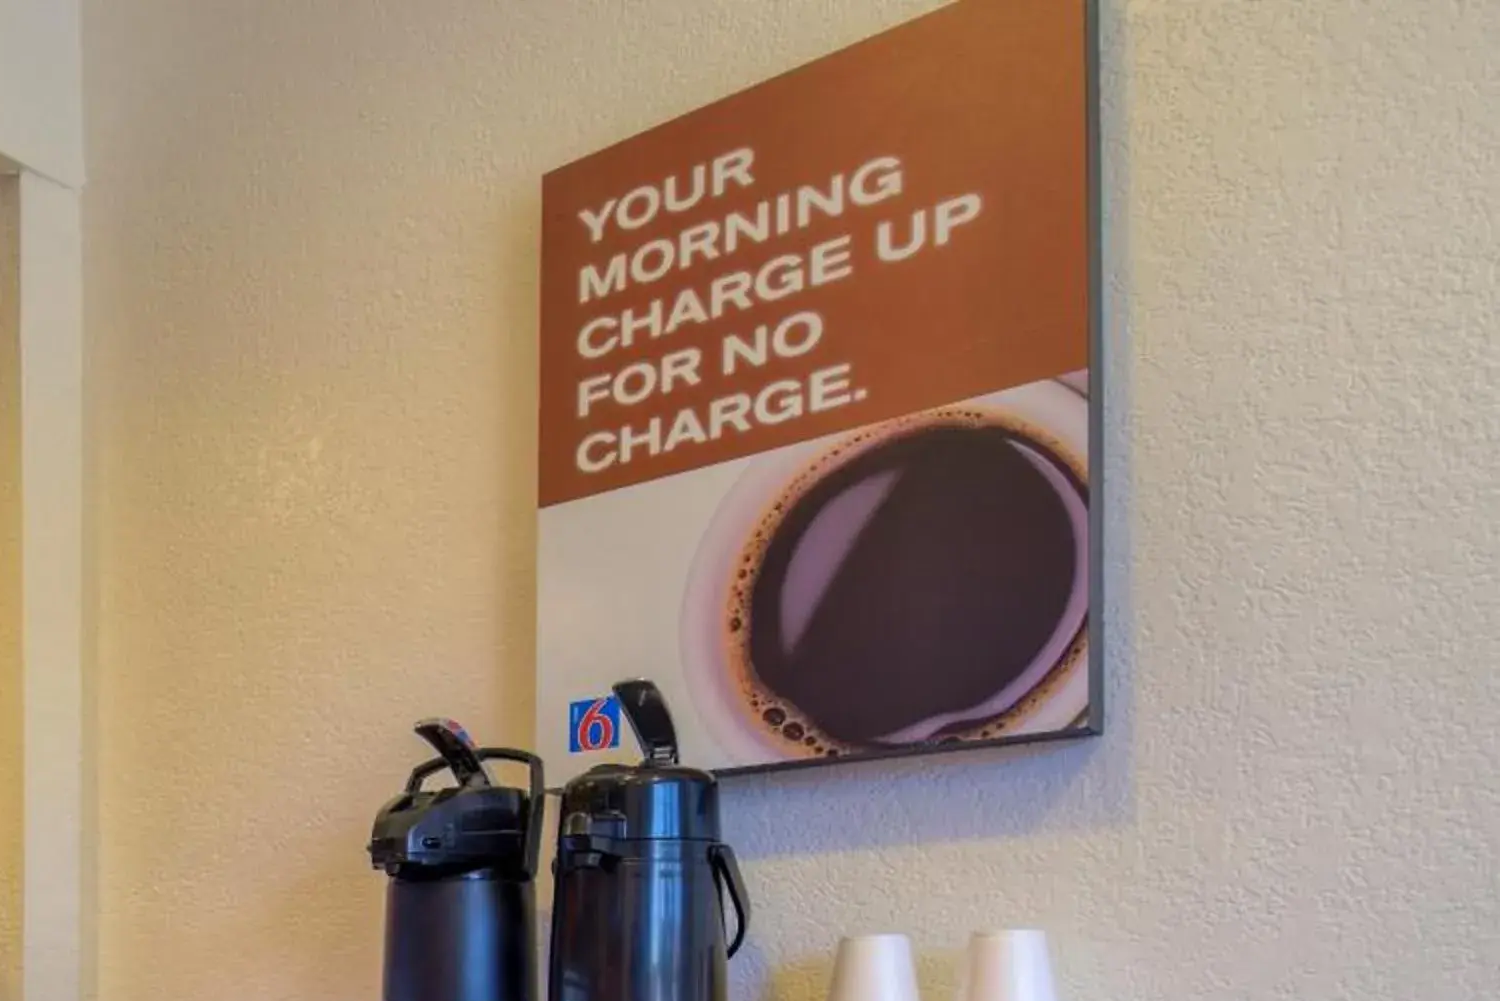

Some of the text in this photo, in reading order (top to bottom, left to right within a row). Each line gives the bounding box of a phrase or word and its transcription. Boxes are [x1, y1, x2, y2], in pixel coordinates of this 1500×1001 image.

[577, 146, 755, 243] YOUR
[579, 156, 904, 303] MORNING
[576, 193, 983, 359] CHARGE UP
[575, 362, 869, 474] CHARGE.
[576, 310, 823, 418] FOR NO
